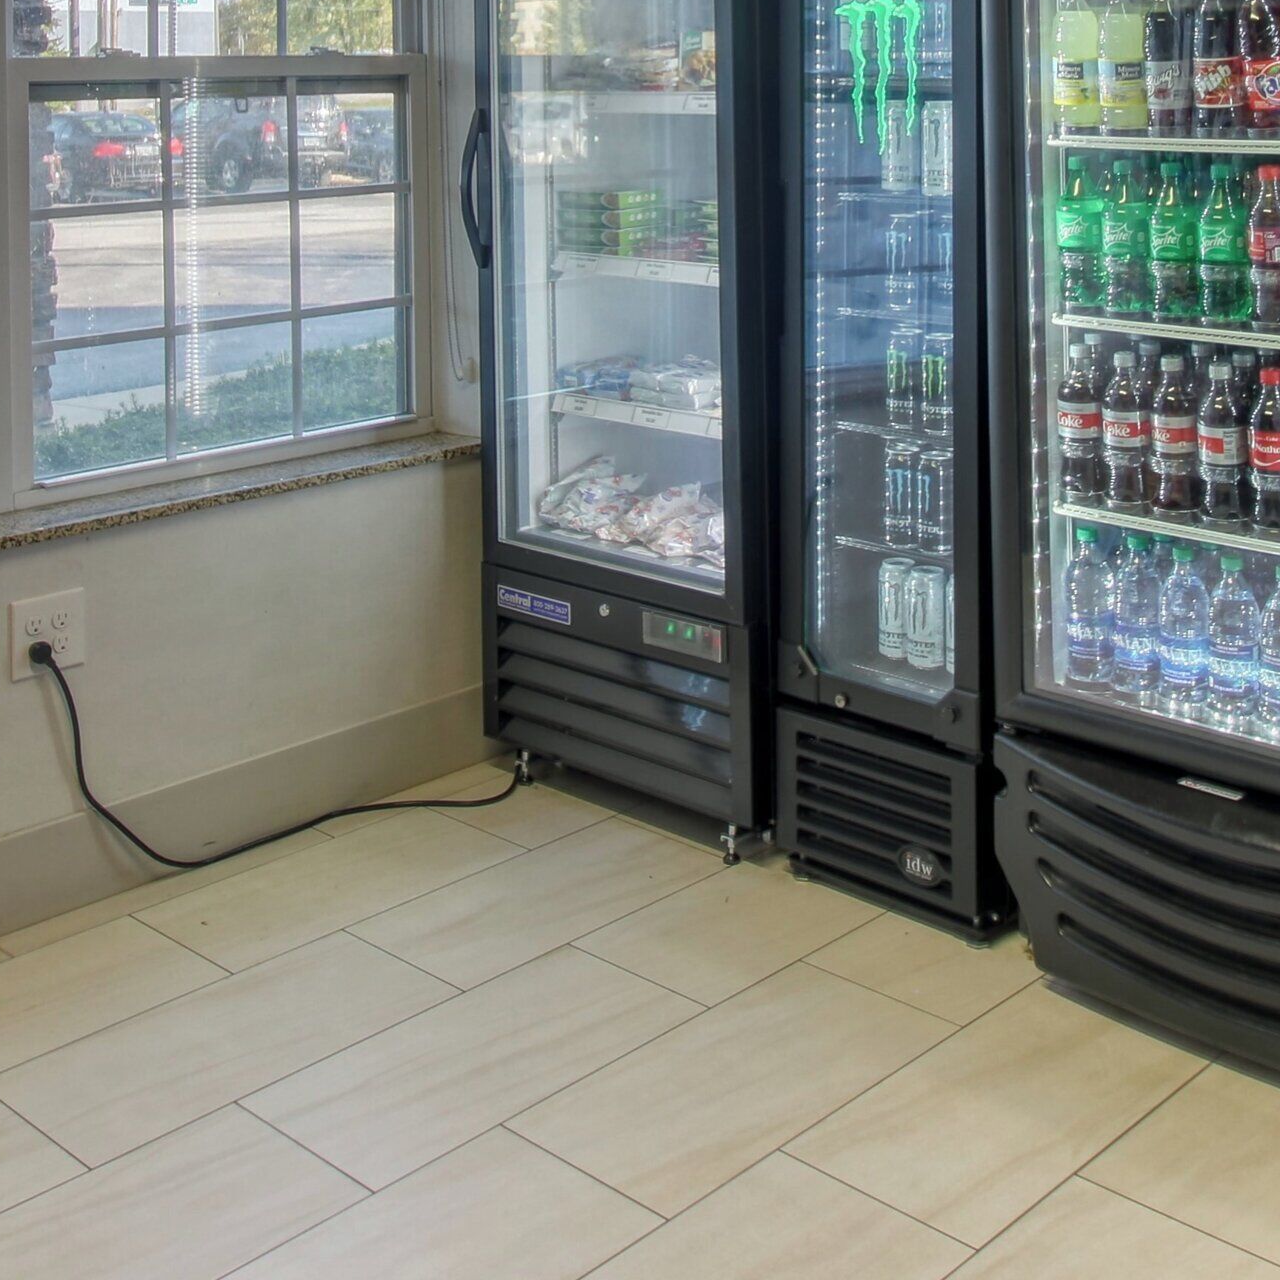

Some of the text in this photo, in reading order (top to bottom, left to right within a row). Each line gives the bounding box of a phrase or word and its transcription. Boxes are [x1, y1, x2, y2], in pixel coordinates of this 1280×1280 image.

[1059, 224, 1083, 239] Sprite
[1104, 231, 1129, 244] Sprite
[1152, 233, 1177, 247] Sprite
[1201, 235, 1228, 249] Sprite
[1057, 411, 1083, 428] Coke
[1102, 420, 1131, 437] Coke
[498, 588, 531, 607] Central
[905, 852, 933, 876] idw
